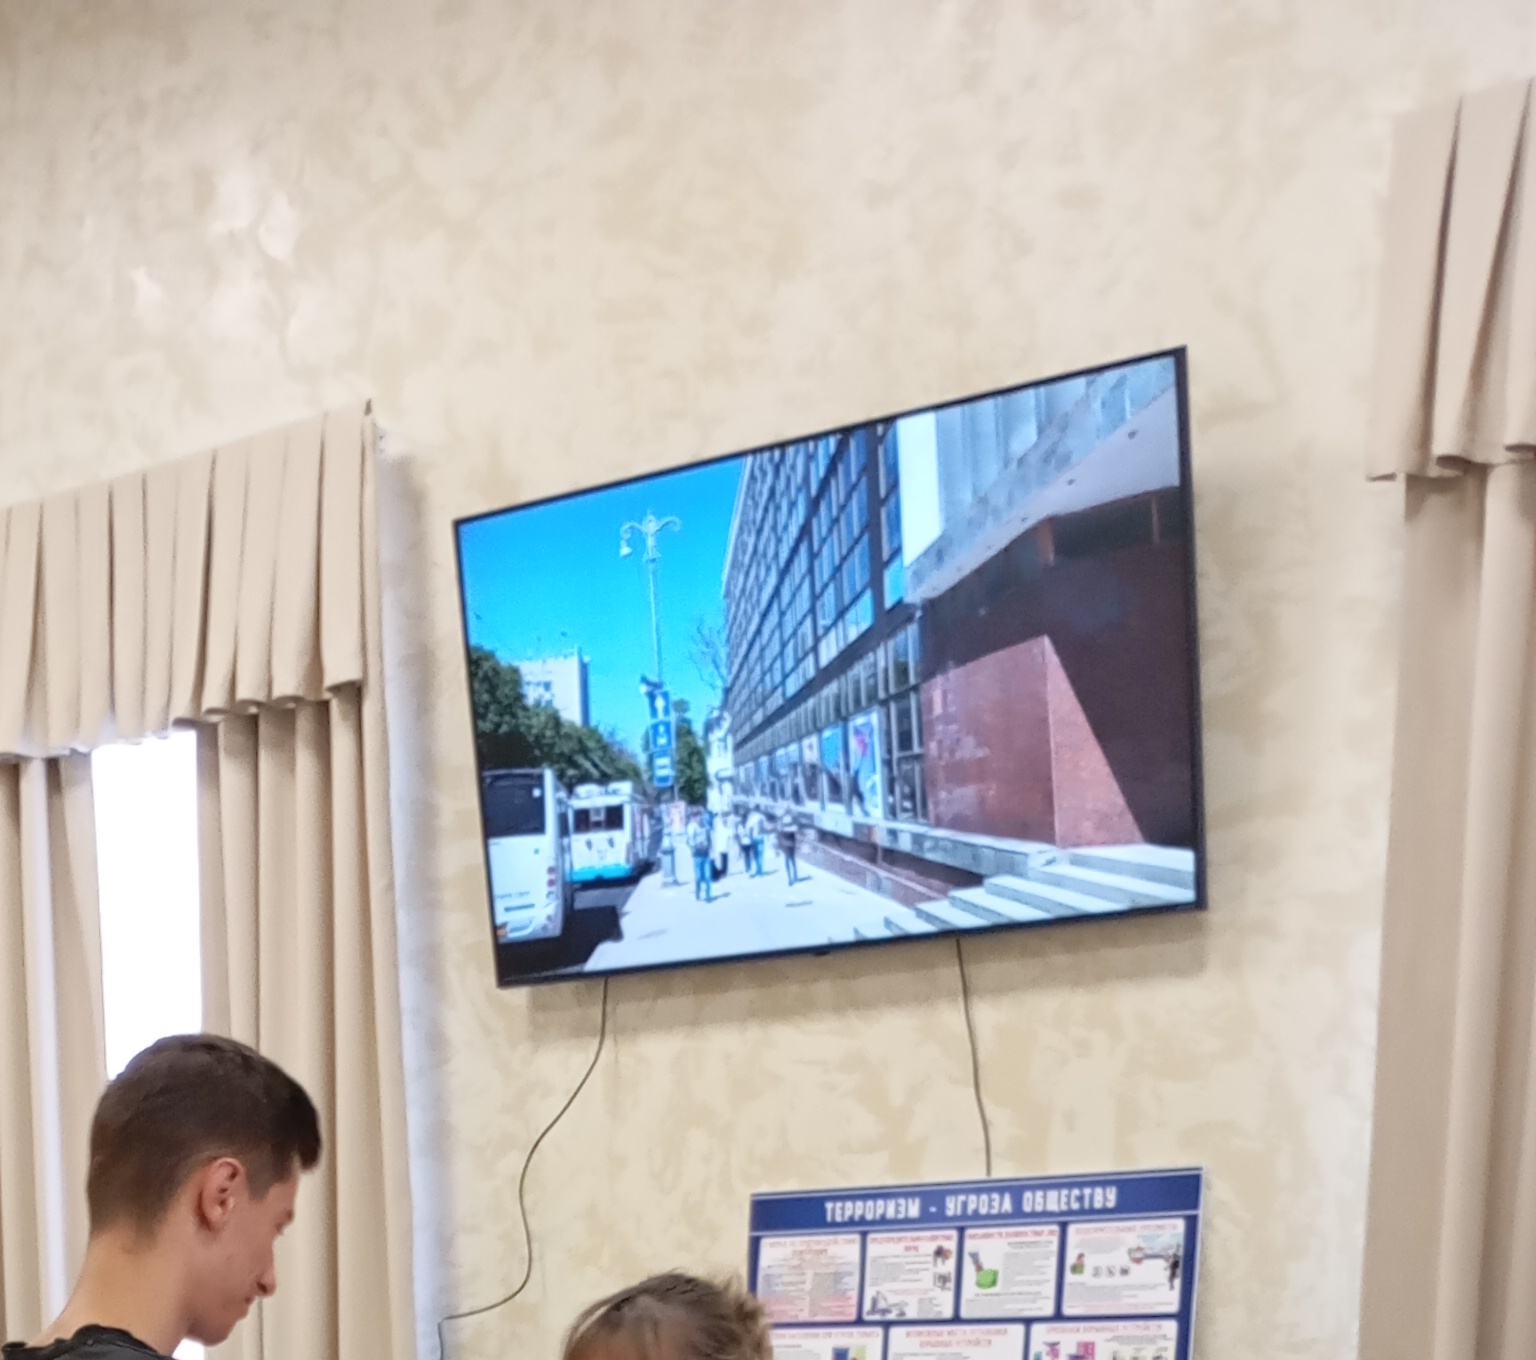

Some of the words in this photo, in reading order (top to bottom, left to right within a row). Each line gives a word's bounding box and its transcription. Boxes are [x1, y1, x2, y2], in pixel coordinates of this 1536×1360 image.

[825, 1197, 920, 1222] ТЕРРОРИЗМ
[945, 1192, 1012, 1217] УГРОЗА
[1022, 1186, 1117, 1213] ОБЩЕСТВУ
